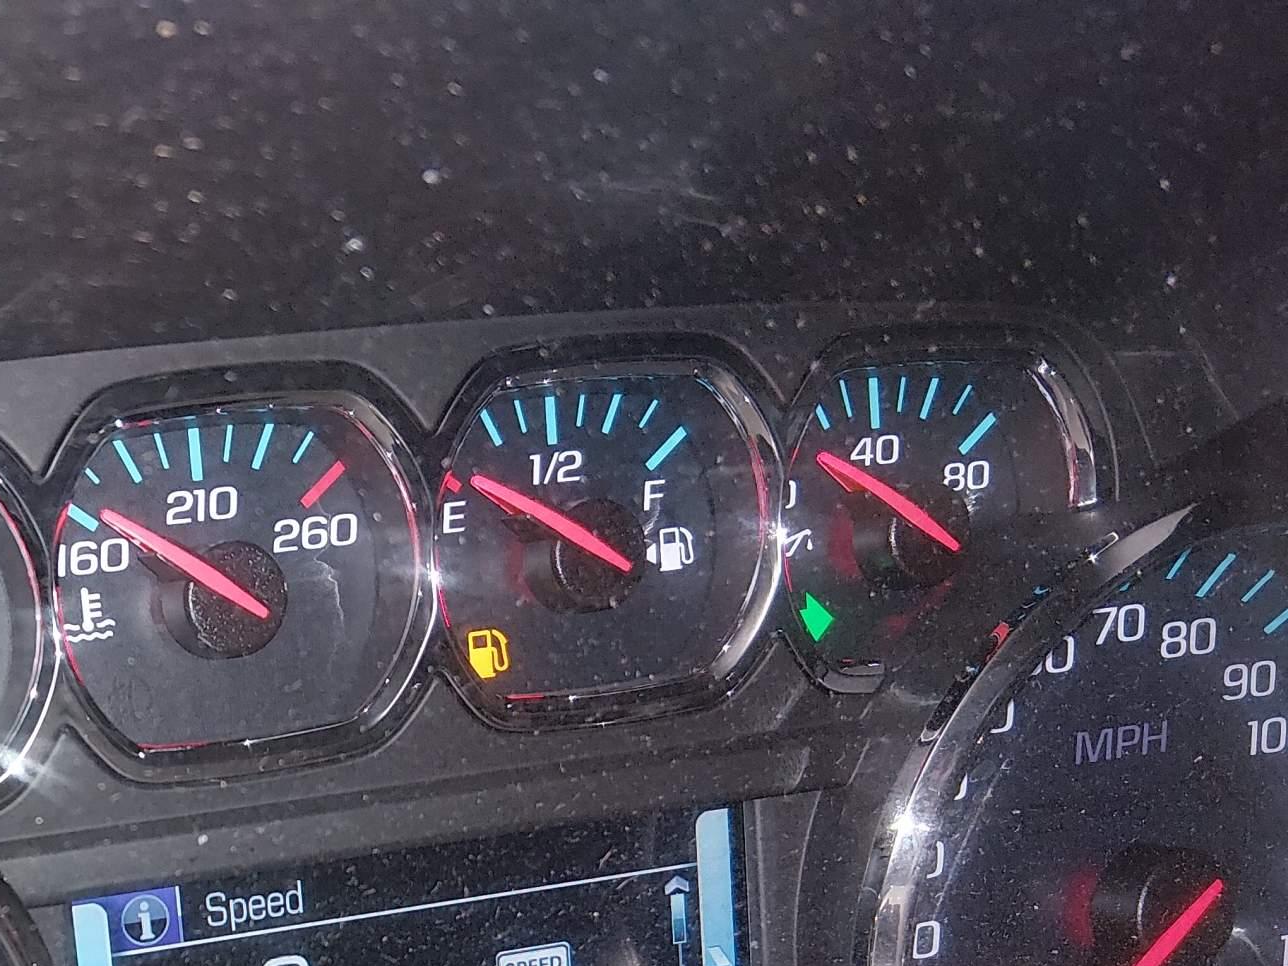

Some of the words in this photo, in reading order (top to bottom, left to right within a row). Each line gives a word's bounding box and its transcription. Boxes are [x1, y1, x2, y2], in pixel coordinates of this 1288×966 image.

[529, 450, 583, 486] 1/2
[850, 435, 900, 466] 40
[643, 480, 666, 511] F
[943, 460, 990, 491] 80
[166, 486, 238, 525] 210
[442, 501, 467, 534] E
[273, 513, 357, 553] 260
[58, 537, 129, 578] 160
[1093, 604, 1146, 645] 70
[1161, 617, 1217, 659] 80
[1222, 660, 1276, 701] 90
[1075, 720, 1168, 765] MPH
[1247, 716, 1288, 756] 10
[206, 880, 305, 934] Speed
